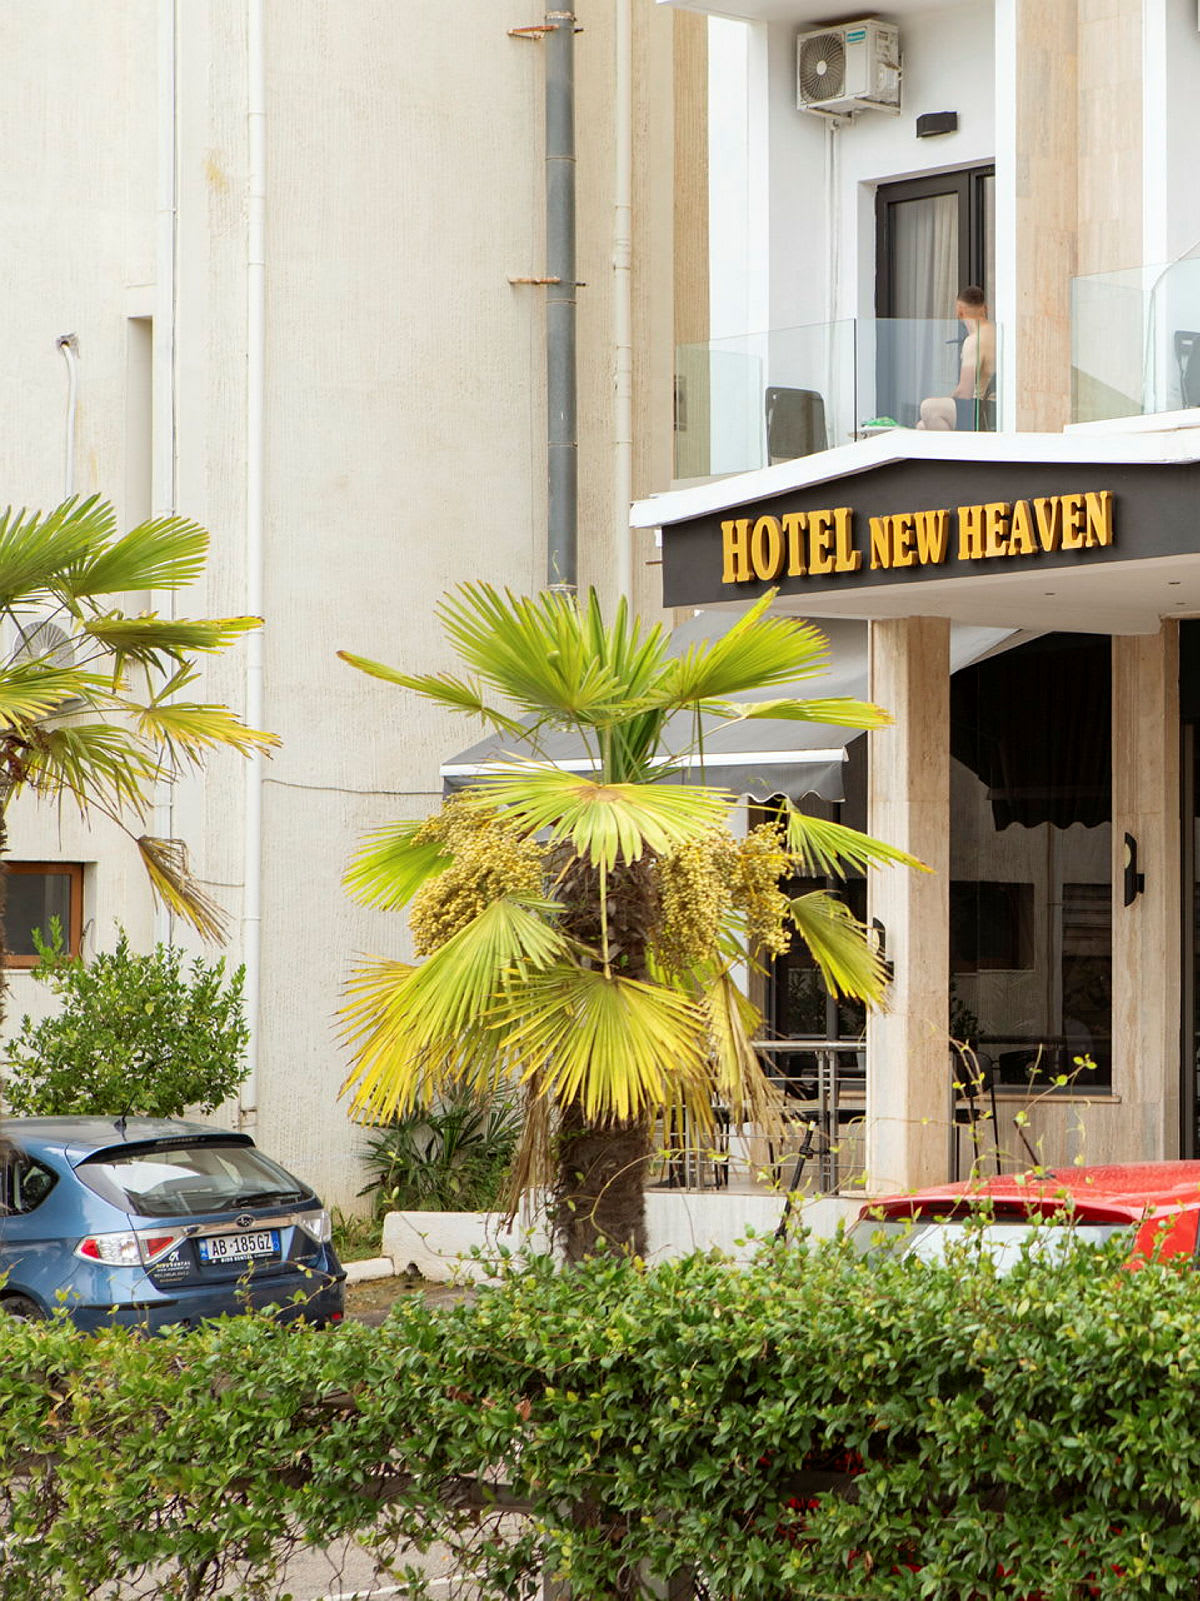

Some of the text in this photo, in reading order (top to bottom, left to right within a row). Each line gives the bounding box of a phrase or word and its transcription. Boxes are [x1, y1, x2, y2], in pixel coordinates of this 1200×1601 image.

[721, 491, 1113, 584] HOTEL NEW HEAVEN
